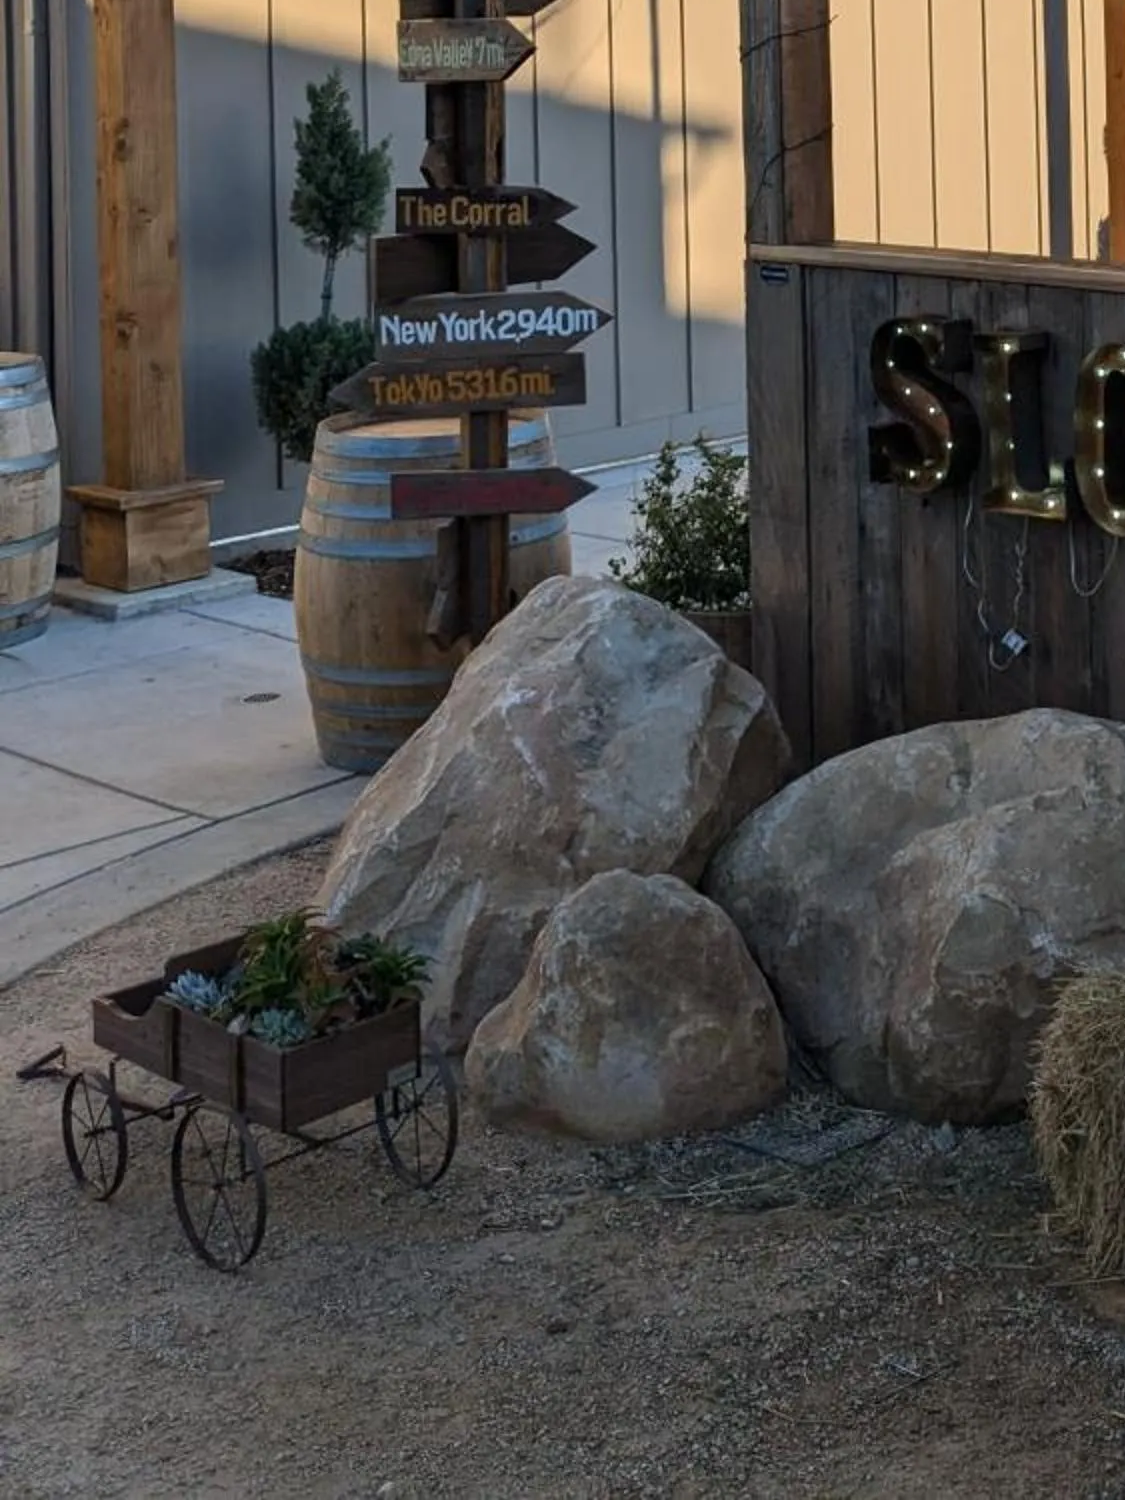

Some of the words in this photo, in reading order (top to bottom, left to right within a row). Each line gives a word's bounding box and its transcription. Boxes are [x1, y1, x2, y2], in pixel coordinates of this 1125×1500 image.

[398, 196, 447, 227] The
[451, 195, 531, 229] Corral
[380, 314, 437, 346] New
[437, 309, 497, 342] York
